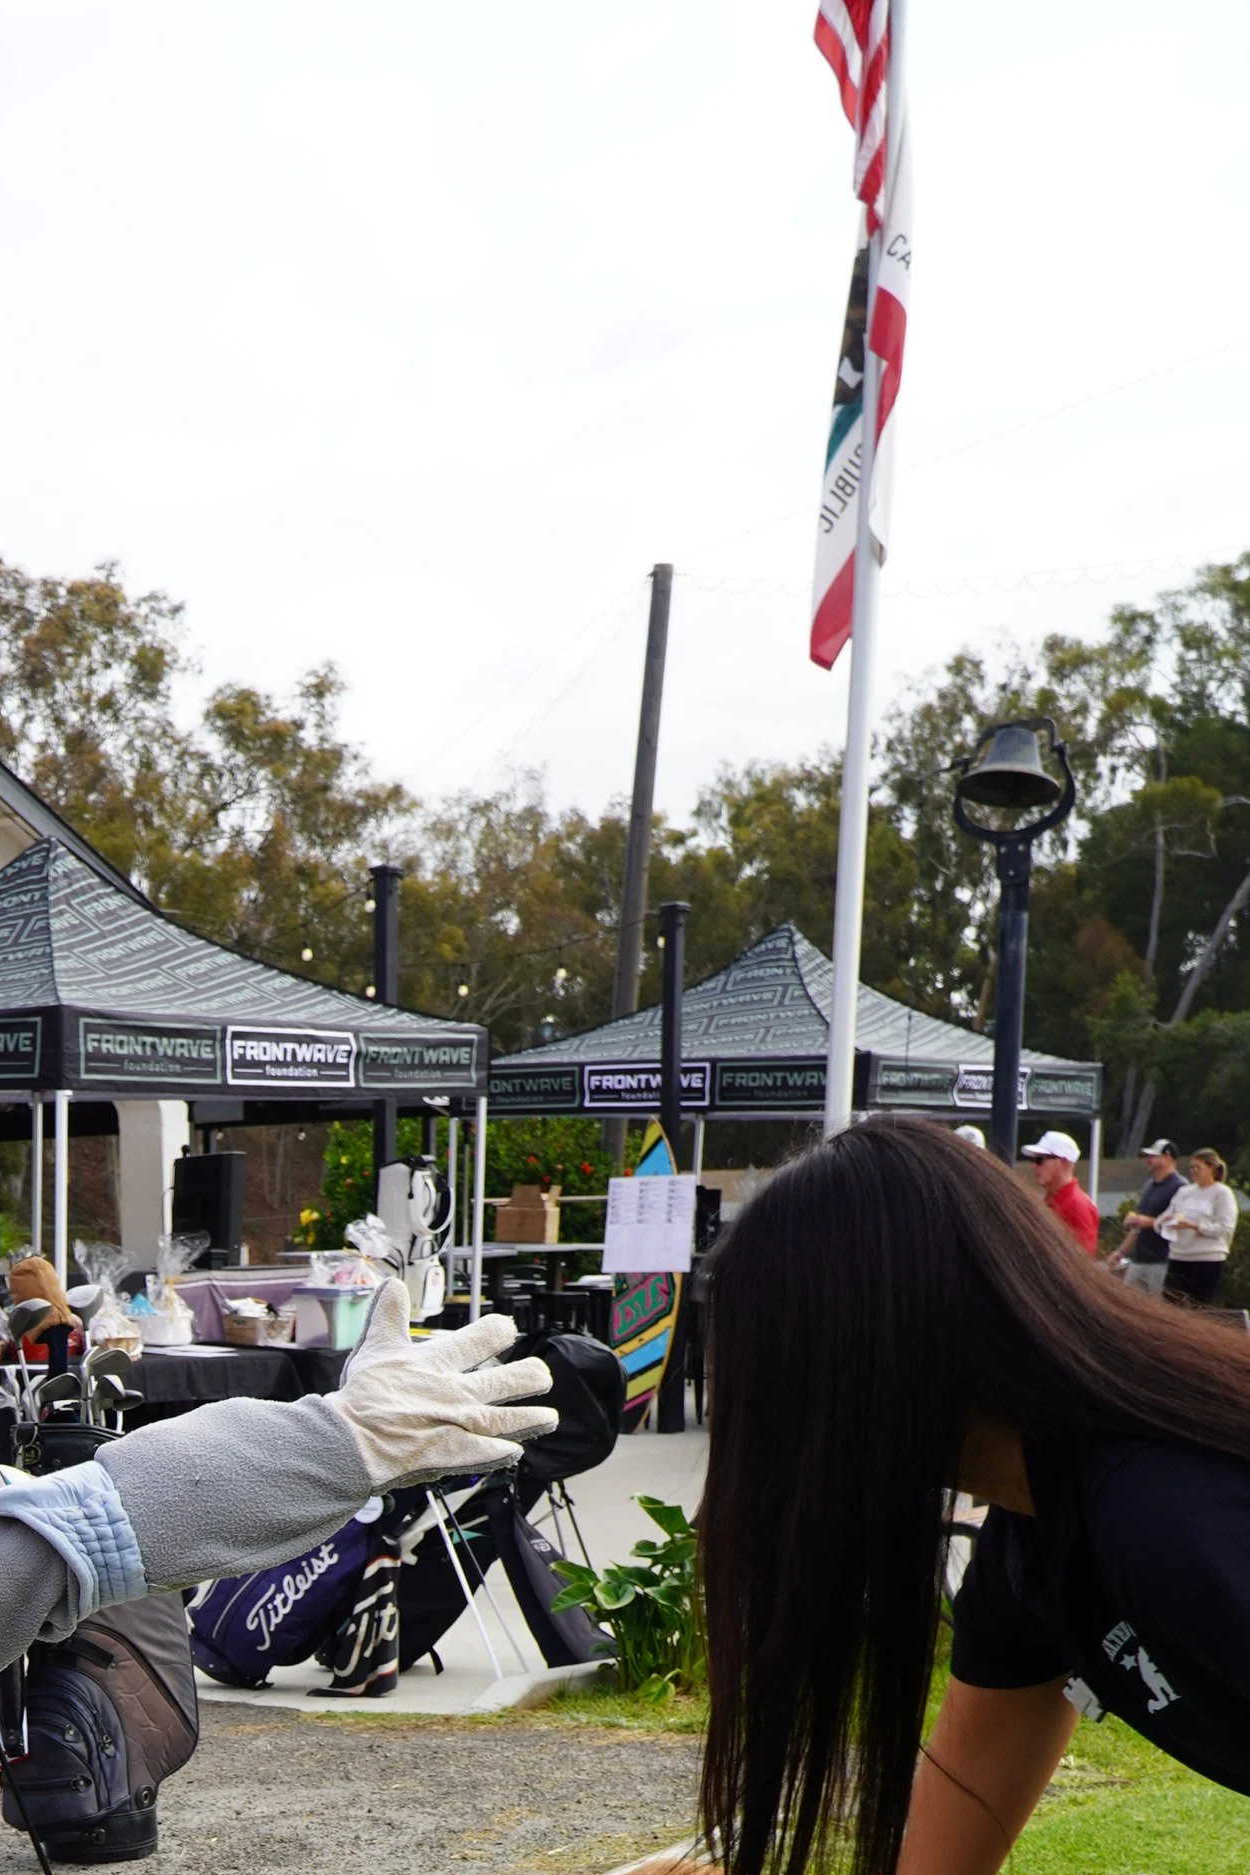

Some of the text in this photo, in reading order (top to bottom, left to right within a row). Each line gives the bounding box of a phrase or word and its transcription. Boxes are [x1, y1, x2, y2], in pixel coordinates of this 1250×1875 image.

[886, 233, 912, 271] CA
[85, 1032, 215, 1059] FRONTWAVE
[231, 1040, 352, 1064] FRONTWAVE
[364, 1045, 471, 1066] FRONTWAVE
[264, 1063, 319, 1078] foundation
[721, 1071, 828, 1088] FRONTWAV
[491, 1076, 573, 1094] ONTWAVE
[589, 1073, 704, 1091] FRONTWVE
[245, 1542, 340, 1652] Titleist
